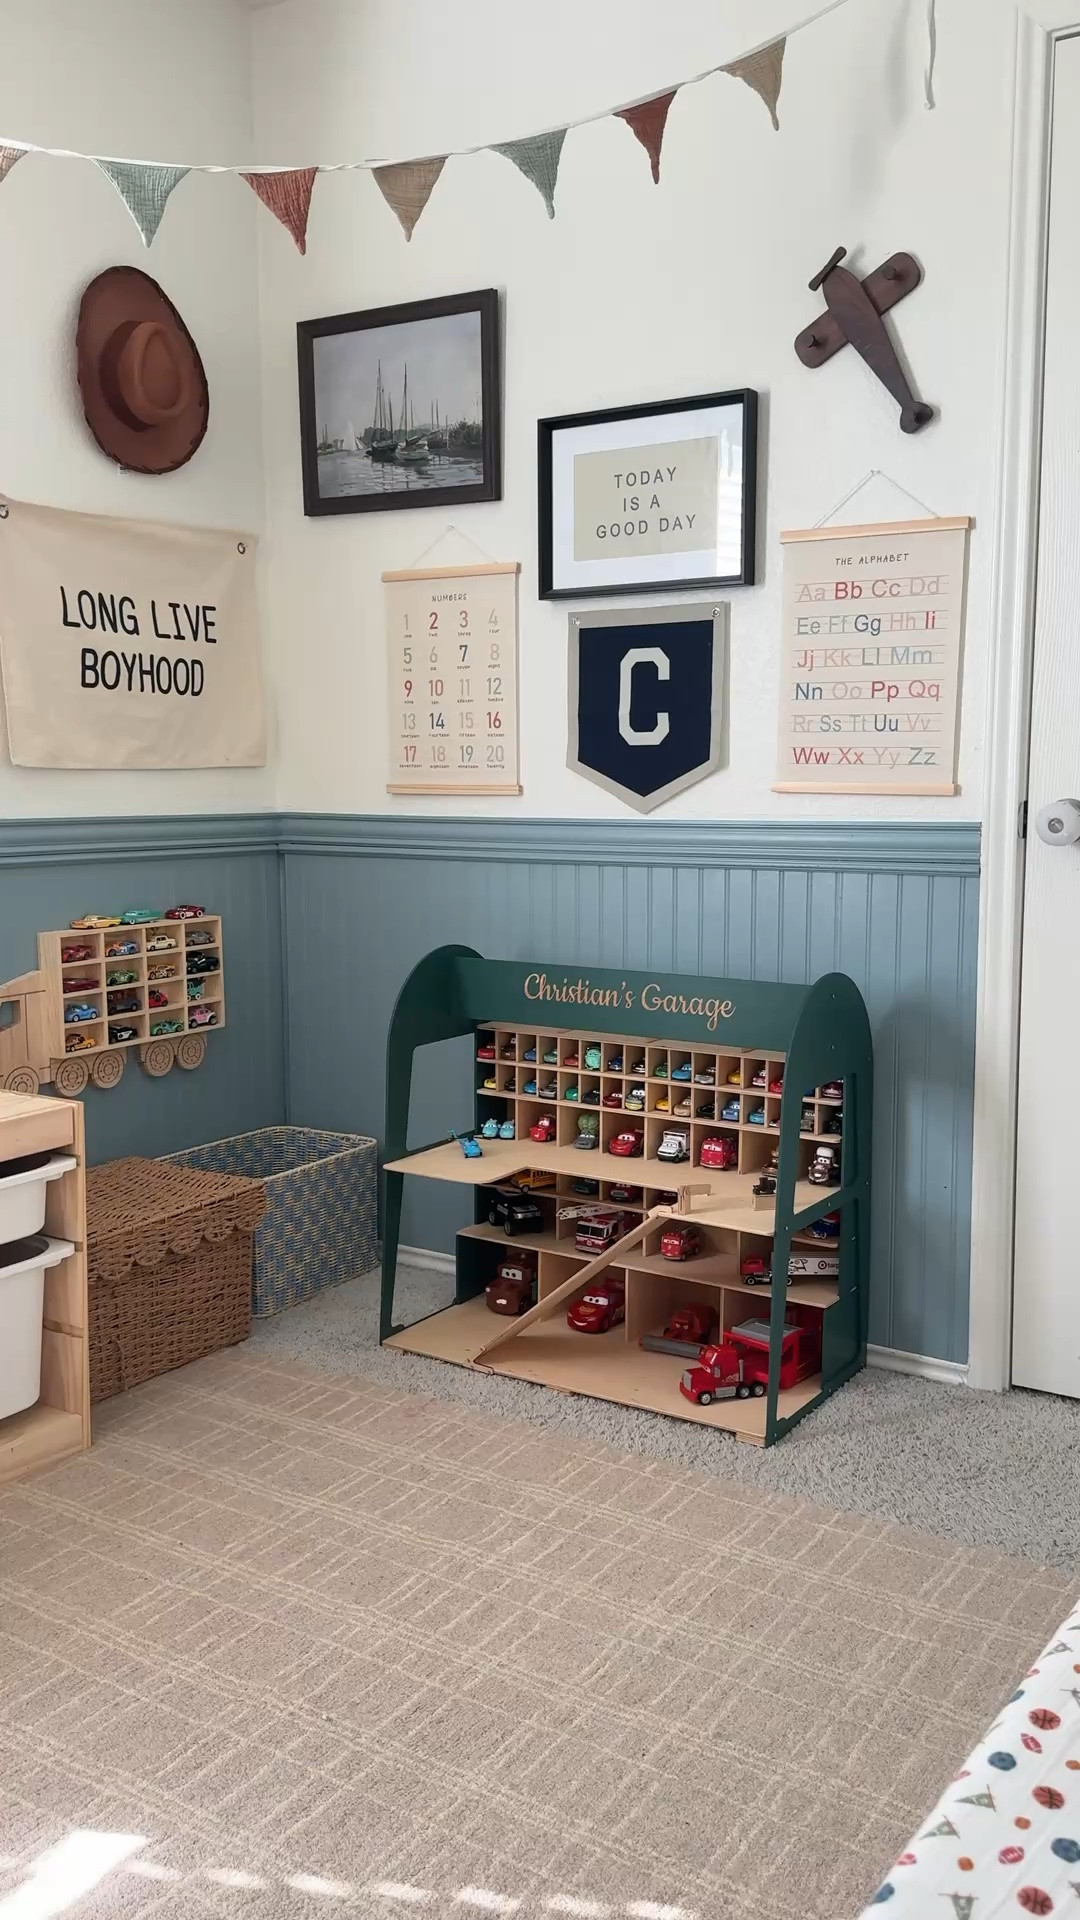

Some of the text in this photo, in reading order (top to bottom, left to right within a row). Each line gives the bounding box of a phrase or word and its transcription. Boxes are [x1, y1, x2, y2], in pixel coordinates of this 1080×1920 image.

[614, 467, 677, 488] TODAY
[623, 494, 660, 512] IS A
[597, 514, 696, 539] GOOD DAY
[836, 553, 909, 566] THE ALPHABET
[432, 593, 467, 602] NUMBERS
[798, 576, 940, 601] Aa Bb Cc Dd
[60, 586, 216, 643] LONG LIVE
[404, 608, 498, 630] 1 2 3 4
[797, 611, 936, 636] Ee Ff Gg Hh Ii
[404, 644, 499, 664] 5 6 7 8
[797, 647, 932, 671] Jj Kk Ll Mm
[81, 648, 204, 696] BOYHOOD
[404, 678, 502, 697] 9 10 11 12
[619, 647, 670, 746] C
[796, 680, 940, 702] Nn Oo Pp Qq
[402, 711, 501, 730] 13 14 15 16
[793, 715, 930, 732] Rr Ss Tt Uu Vv
[404, 745, 504, 762] 17 18 19 20
[793, 748, 936, 769] Ww Xx Yy Zz
[524, 973, 736, 1031] Christian's Garage
